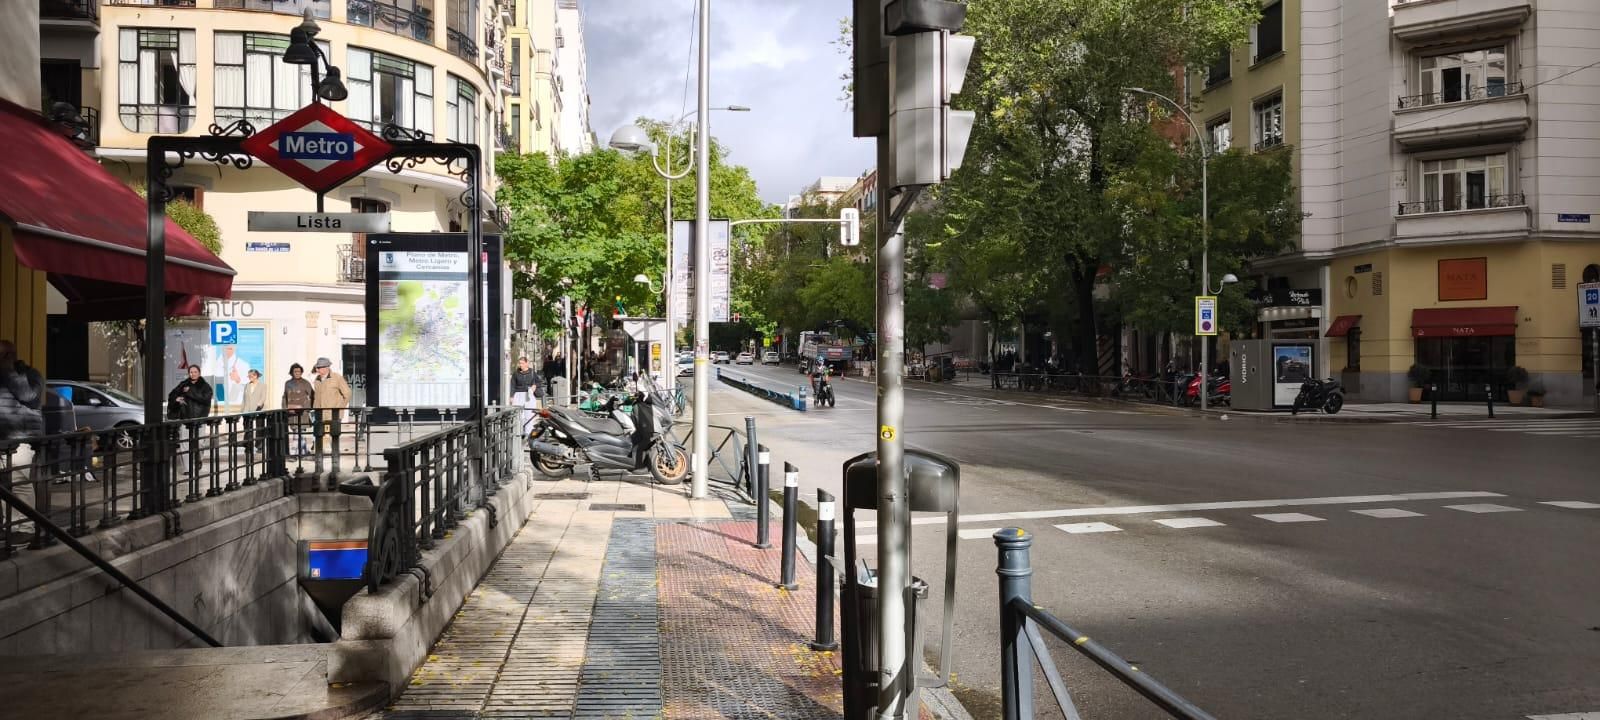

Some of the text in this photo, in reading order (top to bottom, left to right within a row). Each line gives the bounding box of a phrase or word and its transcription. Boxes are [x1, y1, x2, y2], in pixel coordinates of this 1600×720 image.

[285, 135, 349, 155] Metro
[297, 215, 341, 229] Lista
[1587, 293, 1598, 301] 20
[215, 323, 233, 344] P
[1452, 327, 1475, 335] NATA
